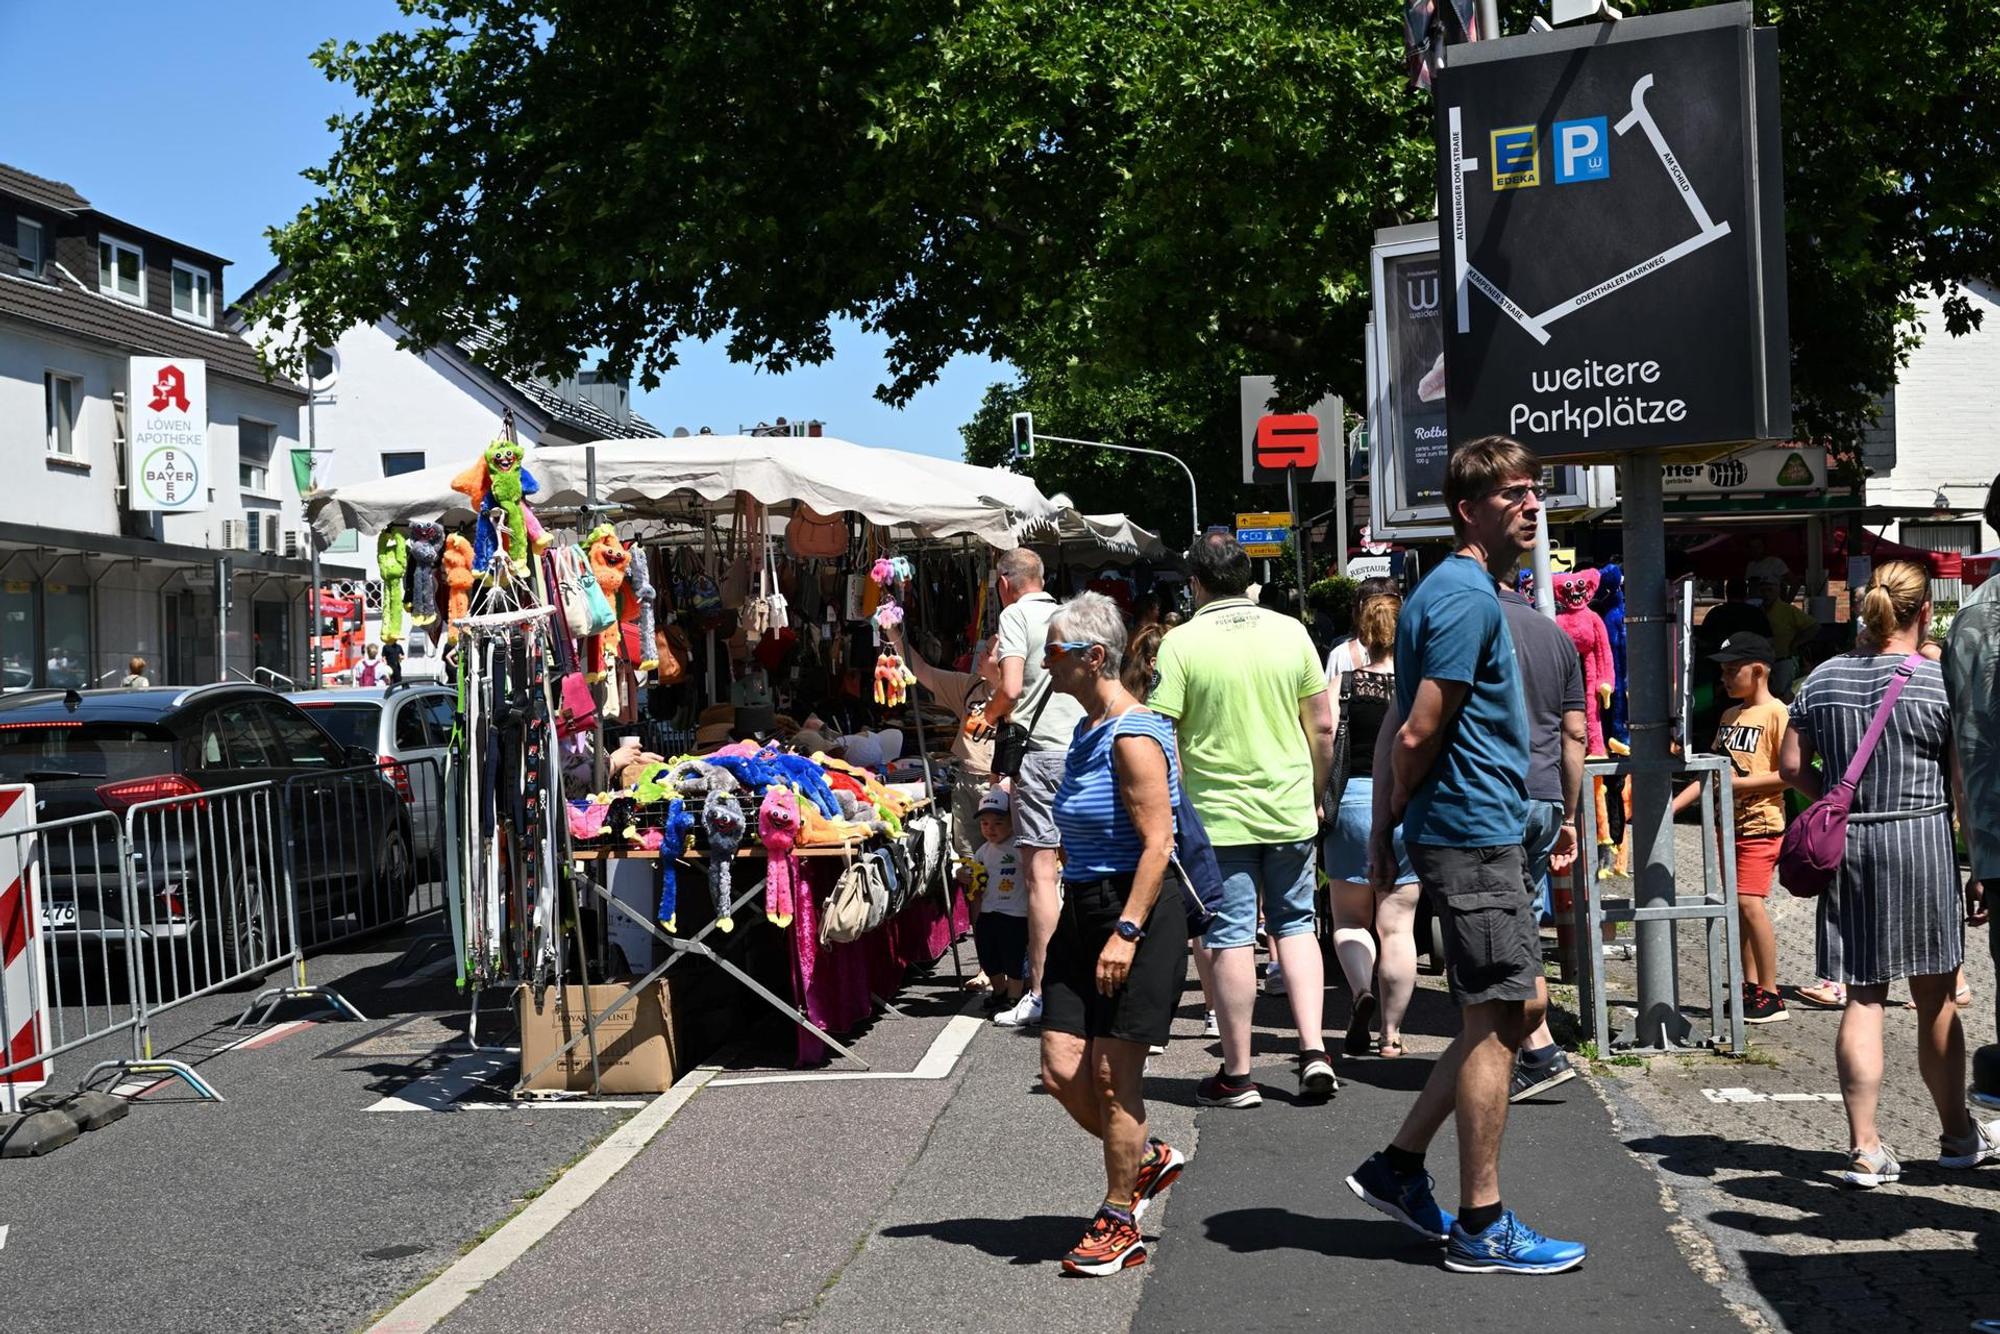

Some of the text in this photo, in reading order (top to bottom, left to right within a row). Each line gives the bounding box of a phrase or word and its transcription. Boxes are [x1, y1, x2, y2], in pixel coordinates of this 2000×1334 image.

[1562, 125, 1599, 177] P
[1454, 163, 1462, 184] DOM
[1497, 175, 1536, 186] EDEKA
[1663, 152, 1690, 192] AM SCHILD
[1455, 185, 1464, 240] ALTENBERGER
[1468, 269, 1501, 301] KEMPENER
[1575, 256, 1666, 306] ODENTHALER MARKWEG
[1532, 359, 1661, 393] weitere
[147, 417, 191, 431] LÖWEN
[1510, 396, 1688, 438] Parkplätze
[136, 433, 201, 446] APOTHEKE
[146, 471, 194, 481] BAYER
[165, 451, 175, 501] BAYER
